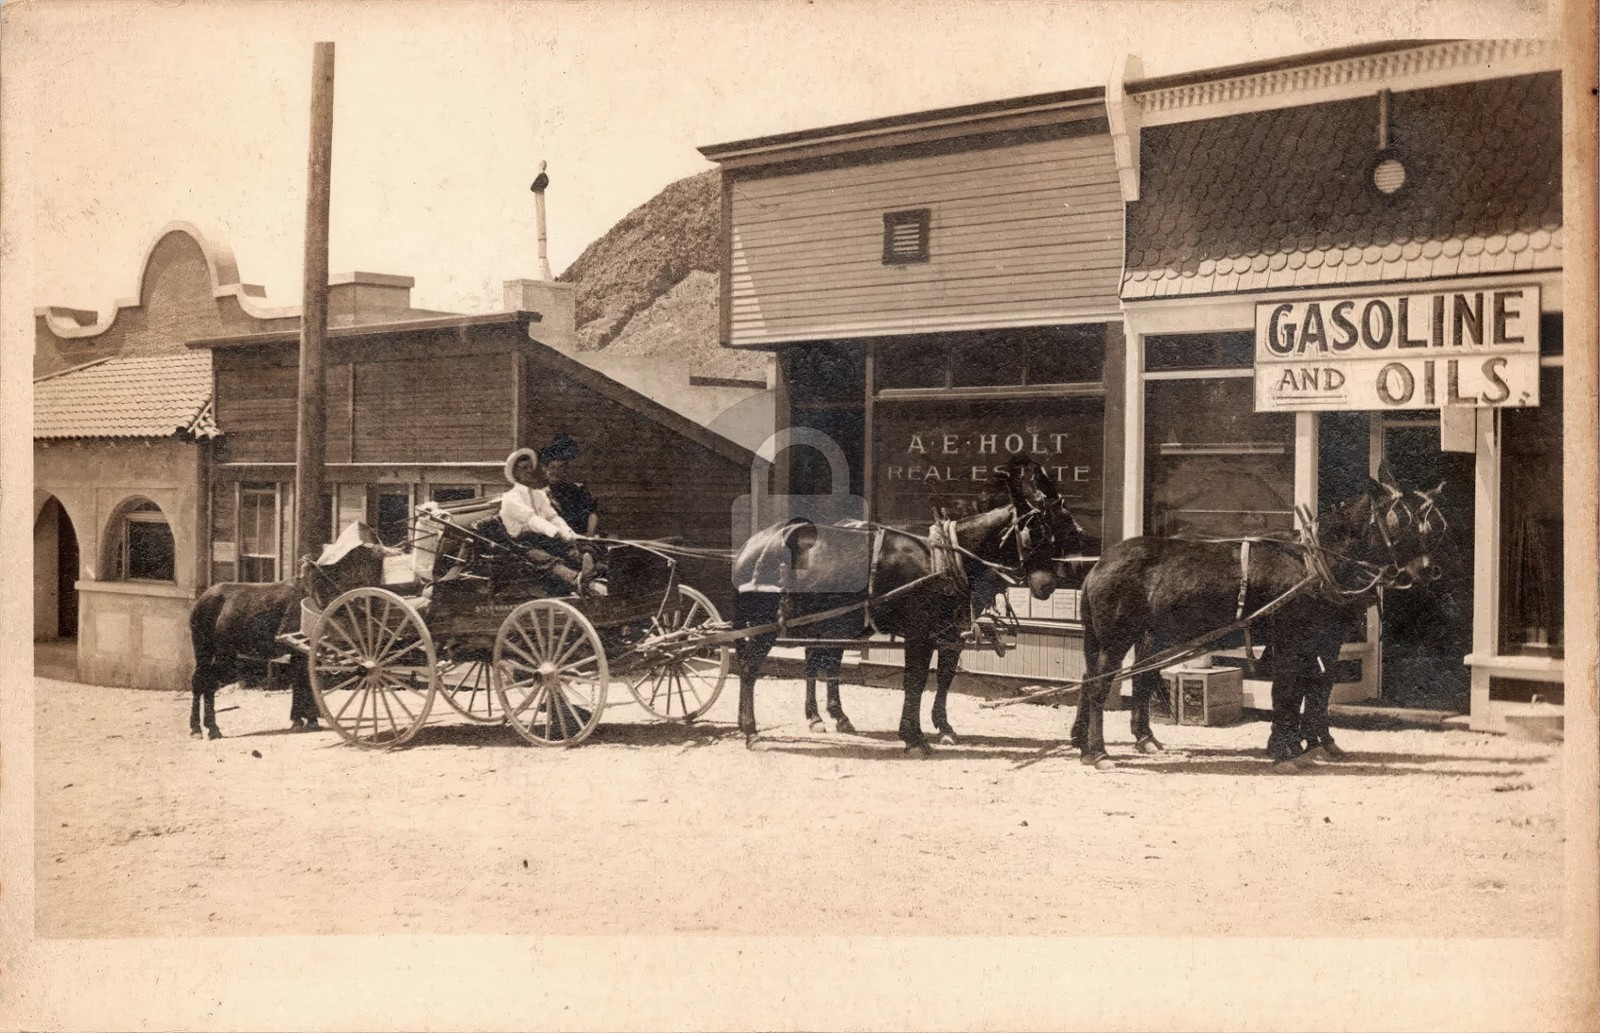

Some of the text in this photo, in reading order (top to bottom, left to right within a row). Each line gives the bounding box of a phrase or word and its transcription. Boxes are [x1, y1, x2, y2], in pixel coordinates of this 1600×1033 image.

[1267, 291, 1525, 355] GASOLINE
[1278, 367, 1346, 392] AND
[887, 465, 959, 482] REAL
